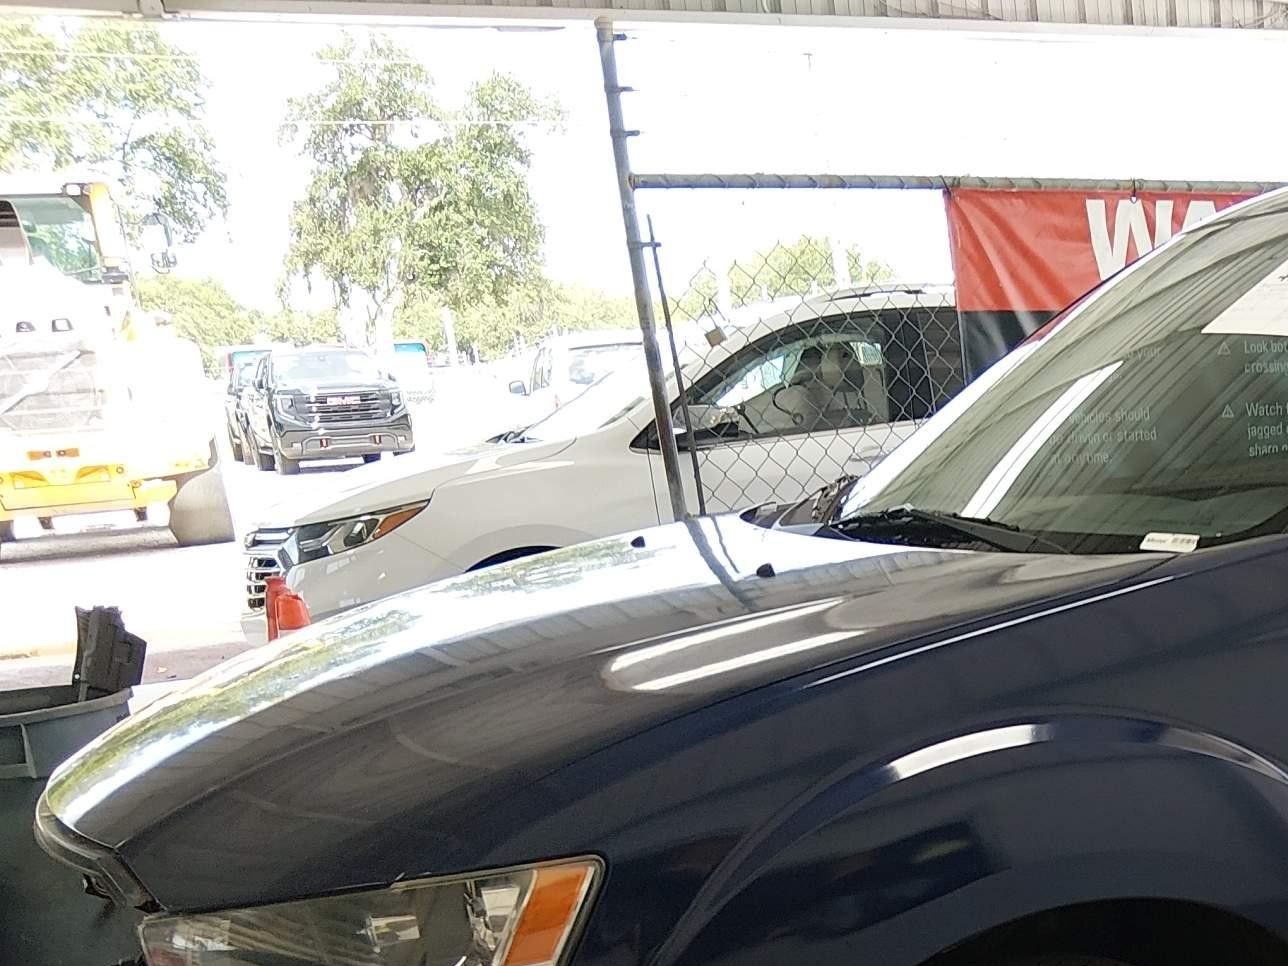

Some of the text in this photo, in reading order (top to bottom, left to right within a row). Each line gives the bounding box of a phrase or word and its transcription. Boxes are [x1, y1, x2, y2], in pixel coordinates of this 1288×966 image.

[1244, 340, 1268, 354] Look
[1116, 406, 1150, 422] should
[1245, 401, 1283, 417] Watch
[1116, 426, 1157, 441] started
[1247, 424, 1283, 440] jagged
